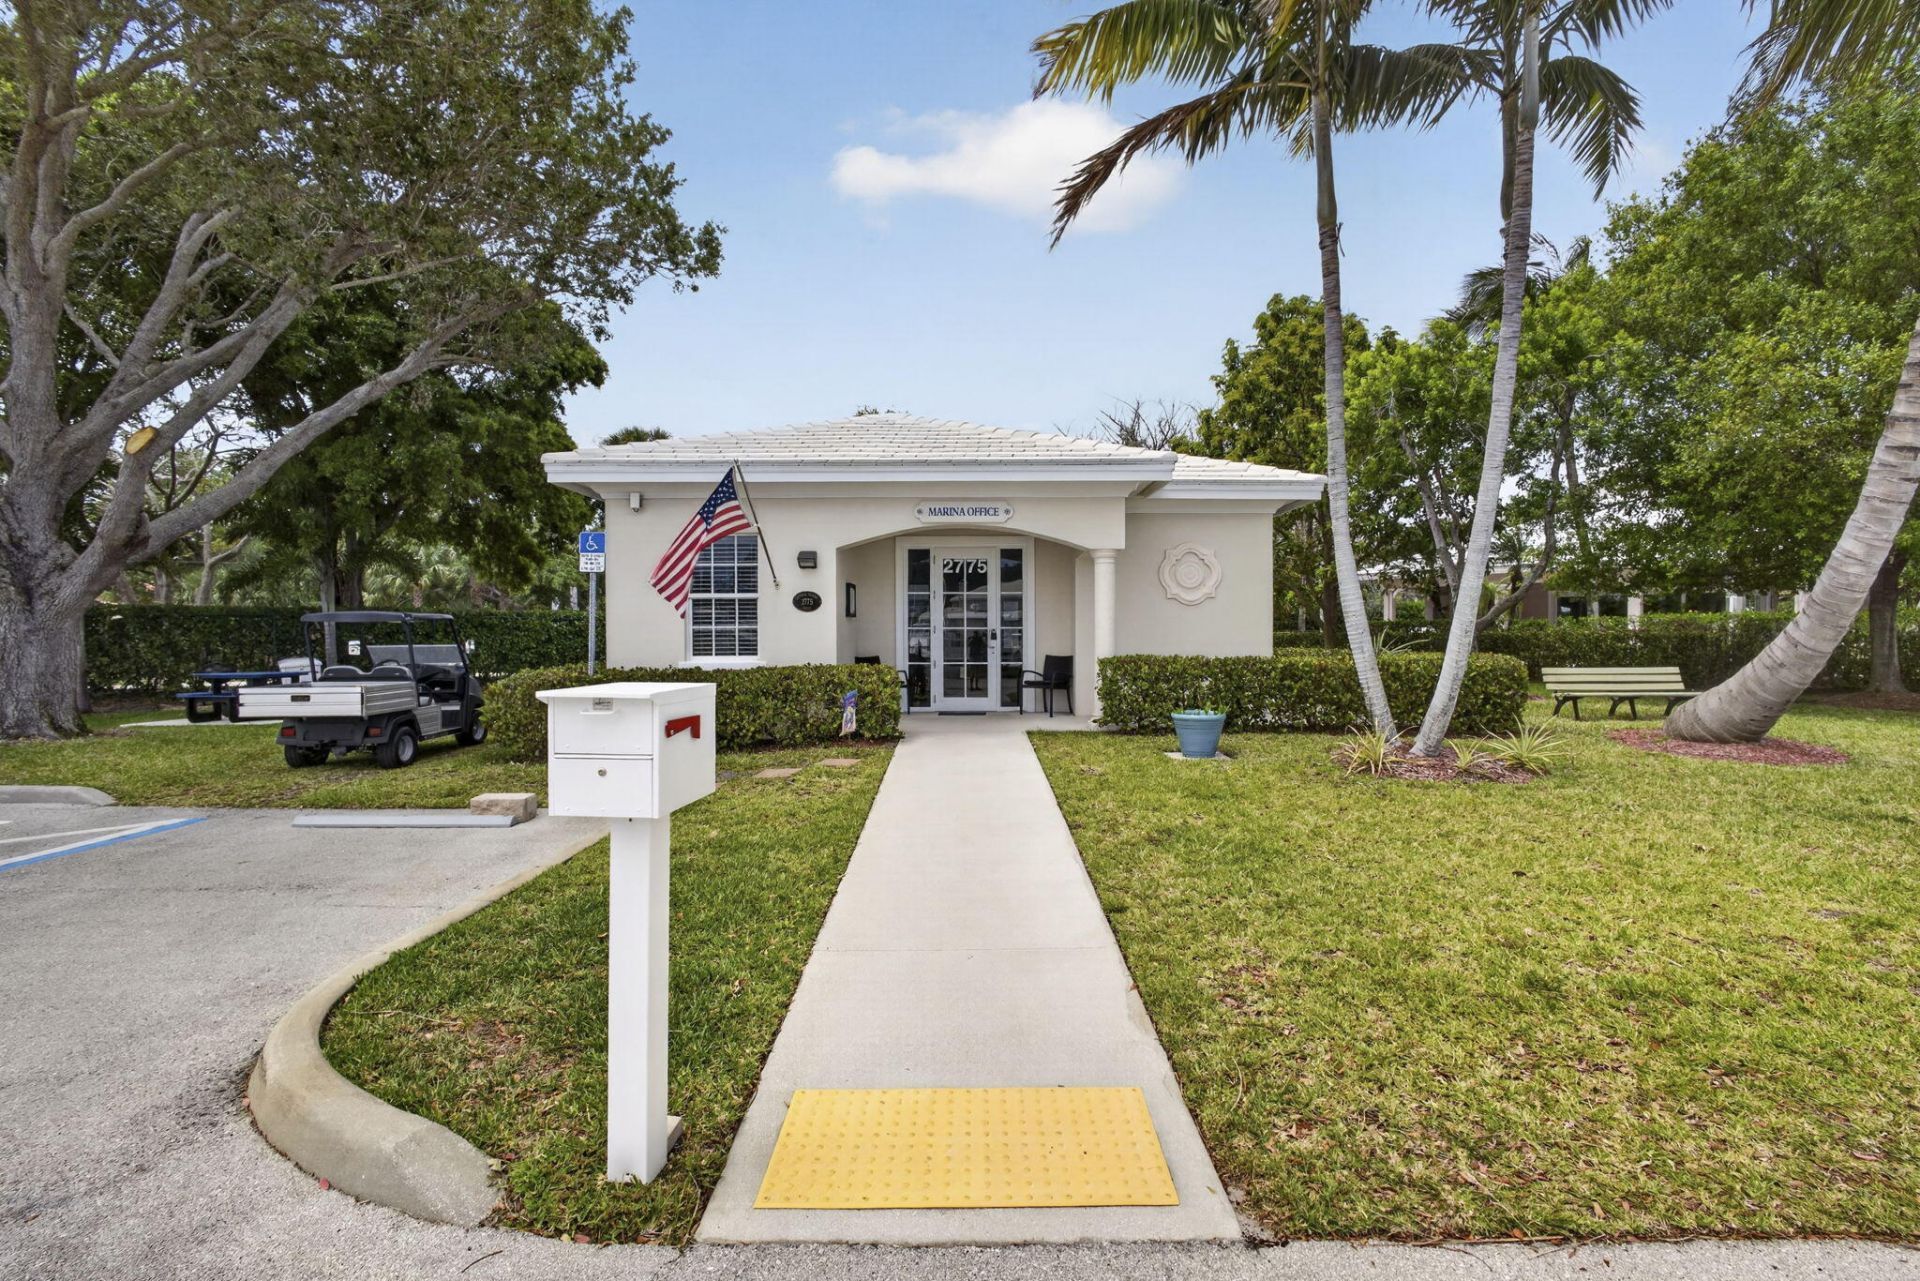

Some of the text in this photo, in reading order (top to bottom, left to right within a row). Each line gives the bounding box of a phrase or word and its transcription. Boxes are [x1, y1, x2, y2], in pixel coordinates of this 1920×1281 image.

[928, 507, 999, 517] MARINA OFFICE
[943, 559, 987, 574] 2775
